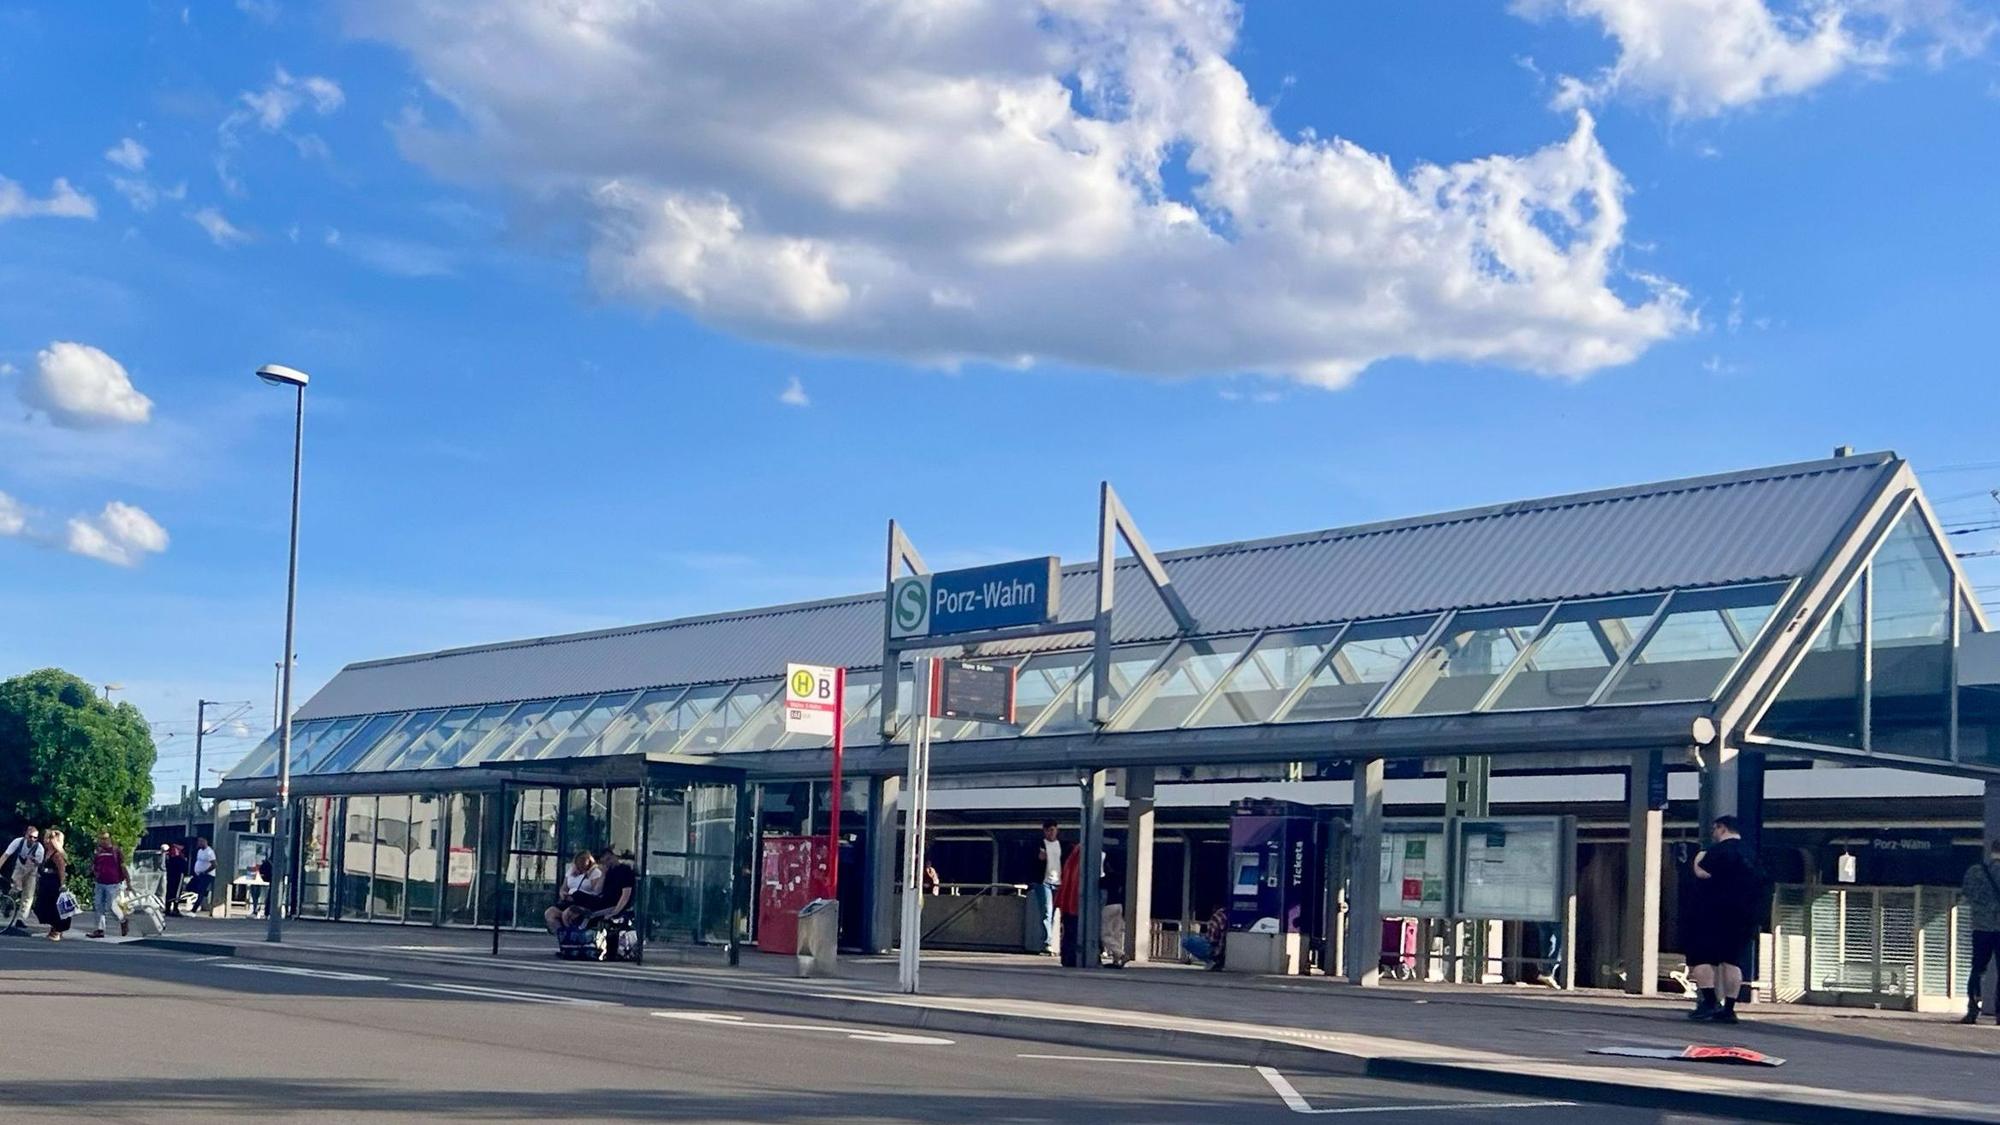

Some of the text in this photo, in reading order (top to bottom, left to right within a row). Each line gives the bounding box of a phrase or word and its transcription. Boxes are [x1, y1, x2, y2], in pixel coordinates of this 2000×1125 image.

[936, 578, 1036, 615] Porz-Wahn
[797, 674, 831, 699] H B
[1873, 838, 1931, 850] Porz-Wahn
[1293, 841, 1304, 887] Tickets
[1844, 857, 1854, 877] 4
